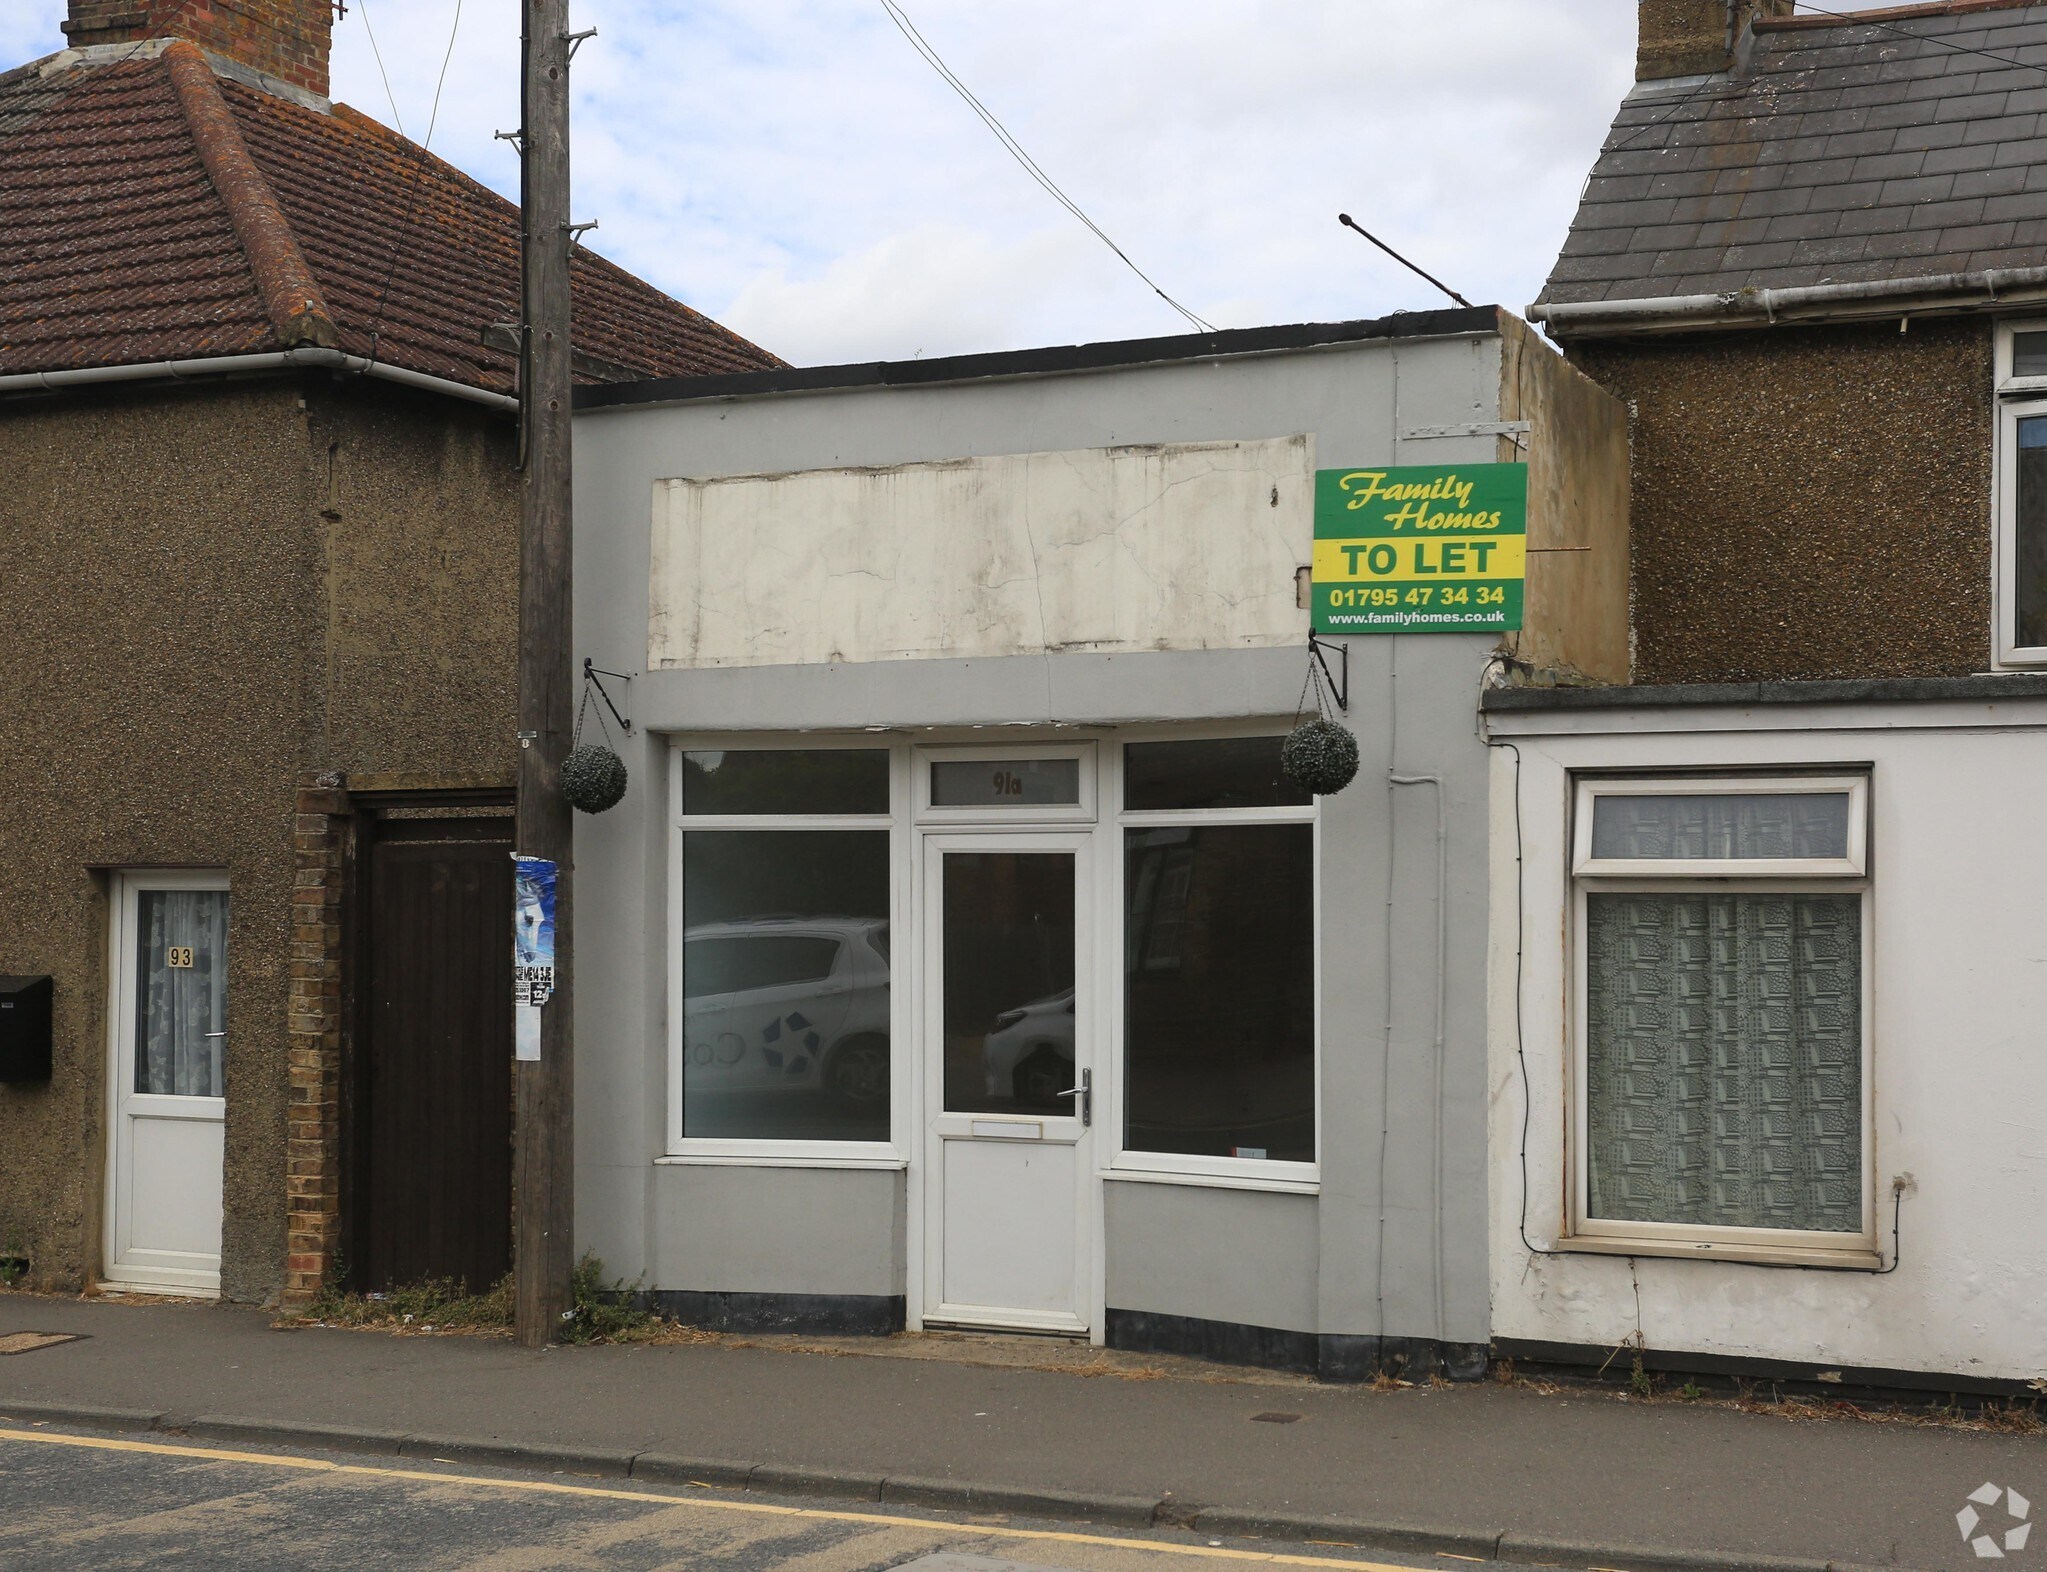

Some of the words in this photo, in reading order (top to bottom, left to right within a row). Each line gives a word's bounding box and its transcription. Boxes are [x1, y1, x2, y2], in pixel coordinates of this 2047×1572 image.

[1339, 472, 1474, 510] Family
[1383, 501, 1501, 530] Homes
[1340, 543, 1397, 575] TO
[1414, 541, 1497, 574] LET
[1329, 588, 1398, 607] 01795
[1405, 587, 1433, 605] 47
[1440, 587, 1468, 605] 34
[1476, 586, 1504, 604] 34
[1328, 611, 1505, 626] www.familyhomes.co.uk
[993, 771, 1022, 795] 91a
[171, 948, 190, 966] 93
